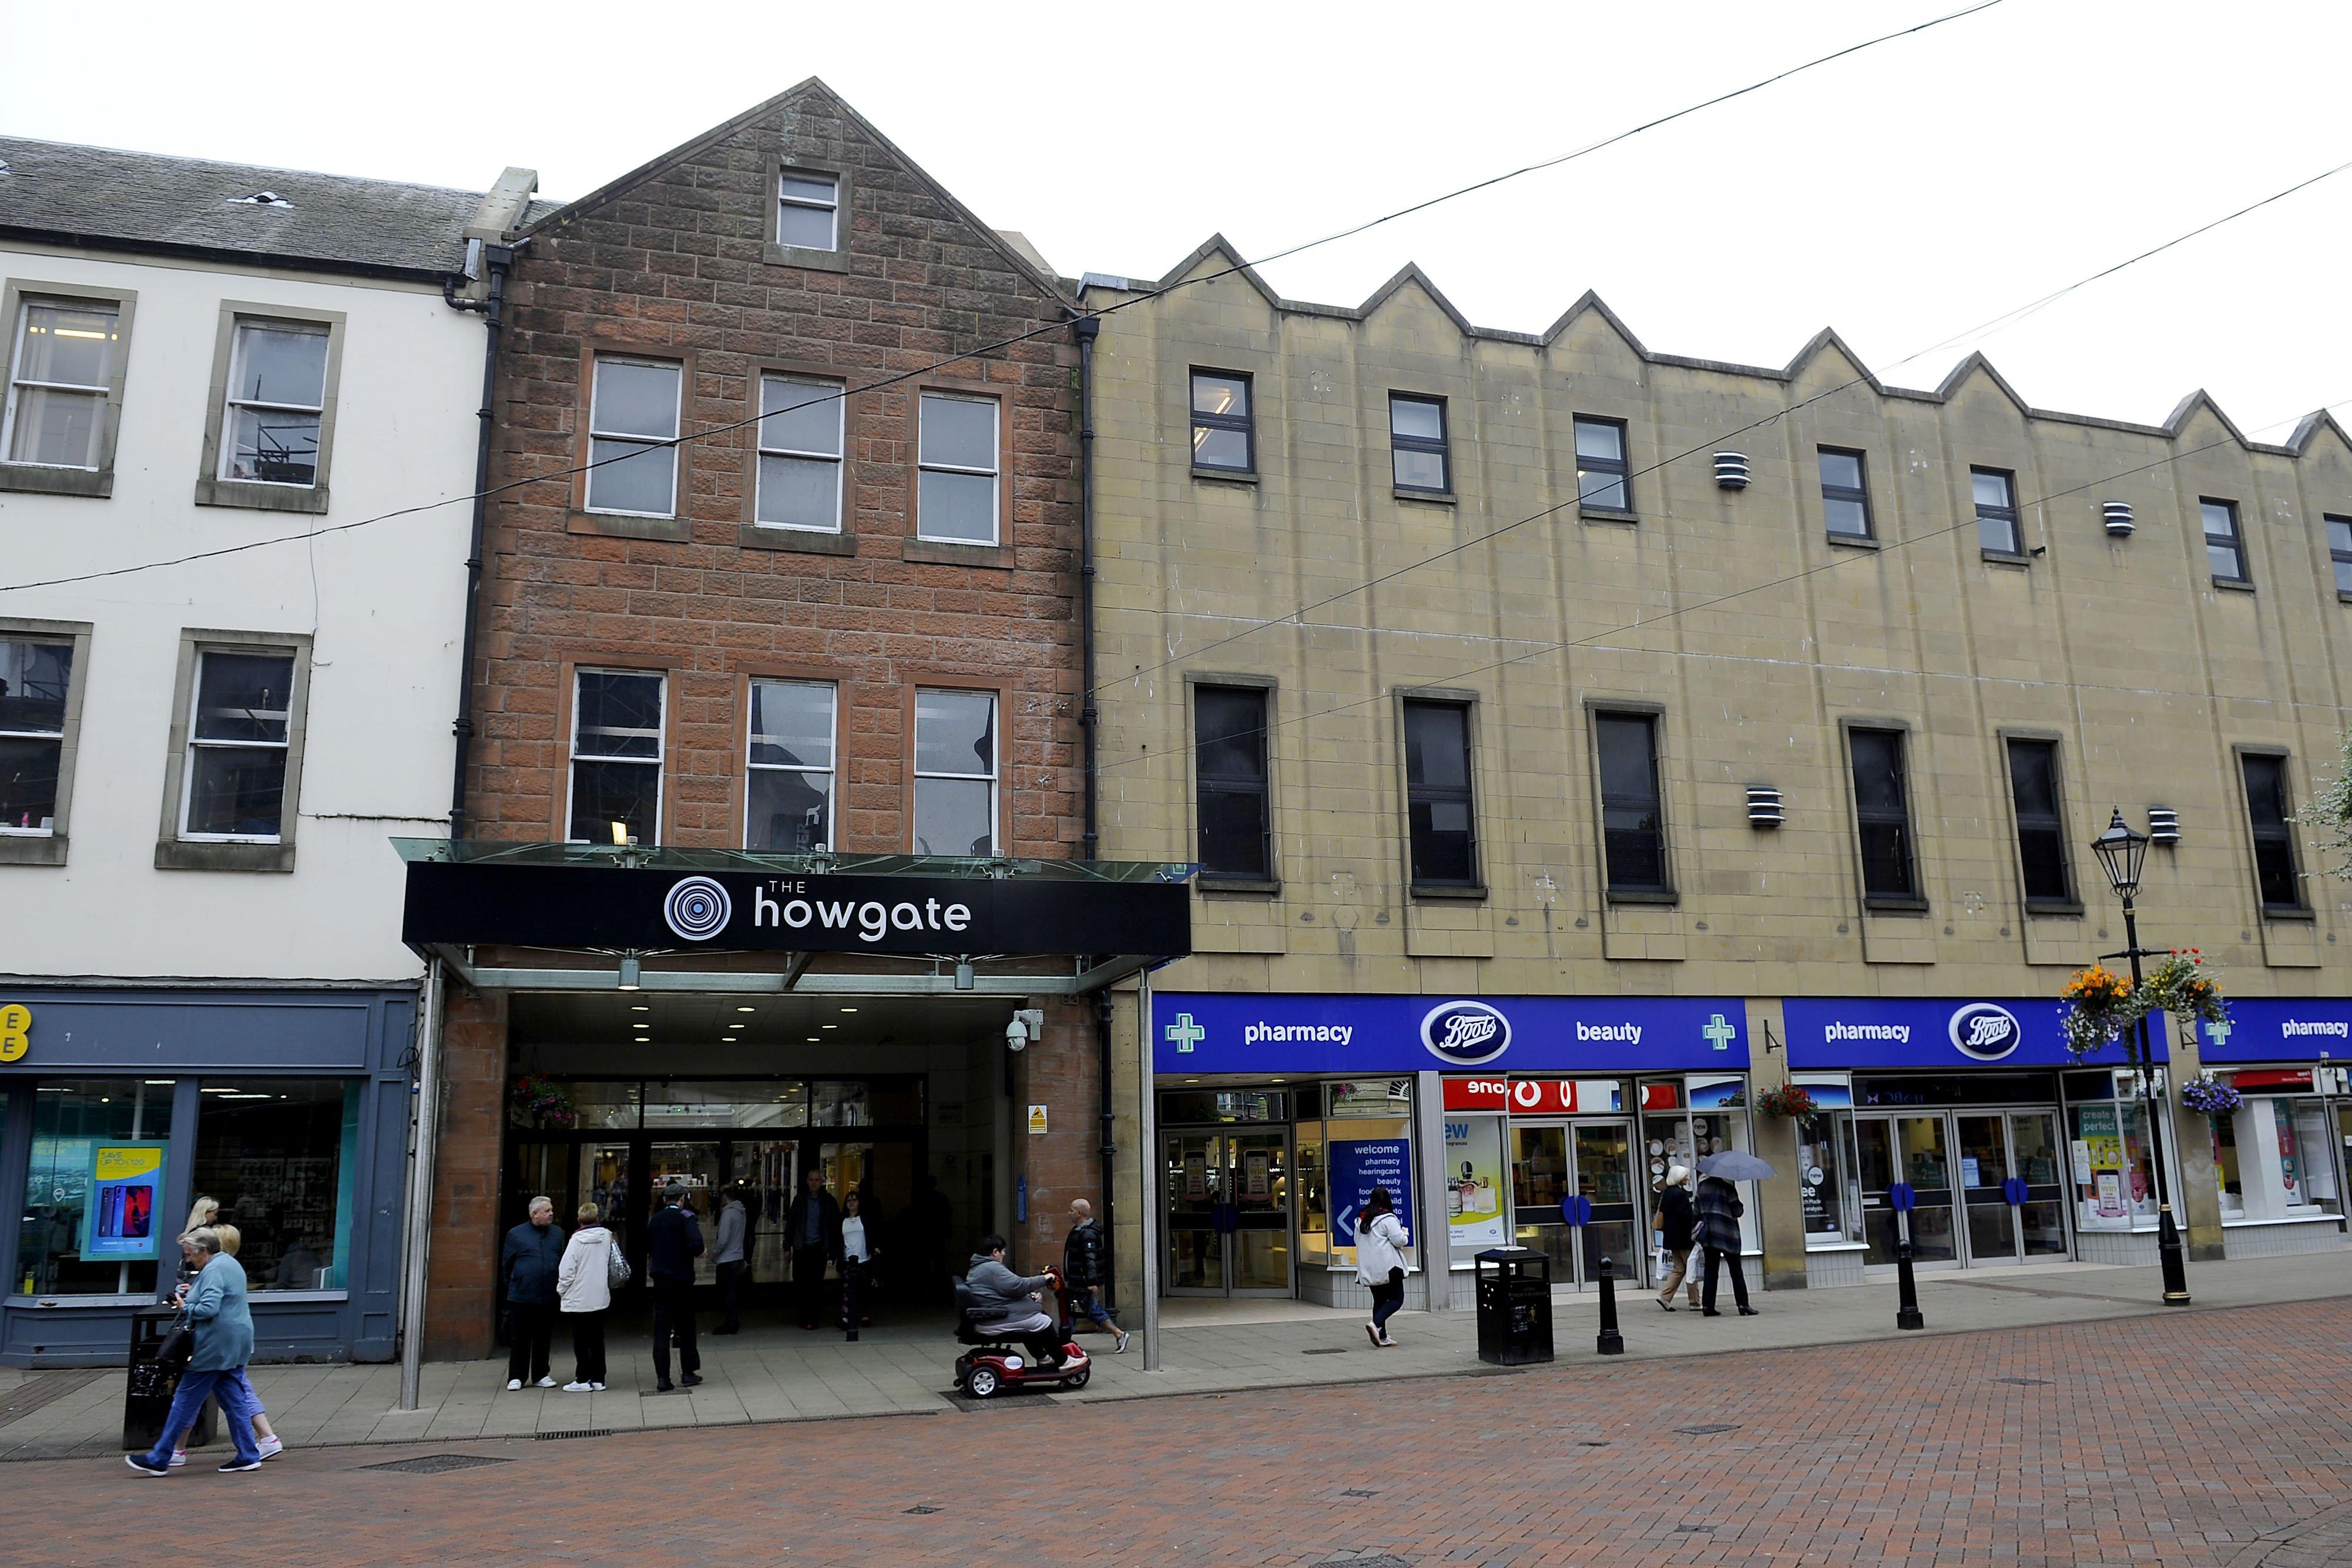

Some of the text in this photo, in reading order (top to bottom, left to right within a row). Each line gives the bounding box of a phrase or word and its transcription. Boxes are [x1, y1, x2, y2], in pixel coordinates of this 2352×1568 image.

[769, 881, 806, 894] THE
[755, 886, 971, 942] howgate
[1244, 1021, 1353, 1046] pharmacy
[1439, 1015, 1497, 1048] Boots
[1576, 1021, 1642, 1046] beauty
[1824, 1020, 1910, 1044] pharmacy
[1966, 1016, 2012, 1046] Boots
[2281, 1018, 2348, 1039] pharmacy
[2083, 1110, 2111, 1119] create
[2083, 1121, 2116, 1132] perfect
[1354, 1144, 1400, 1154] welcome
[1358, 1168, 1401, 1176] hearingcare
